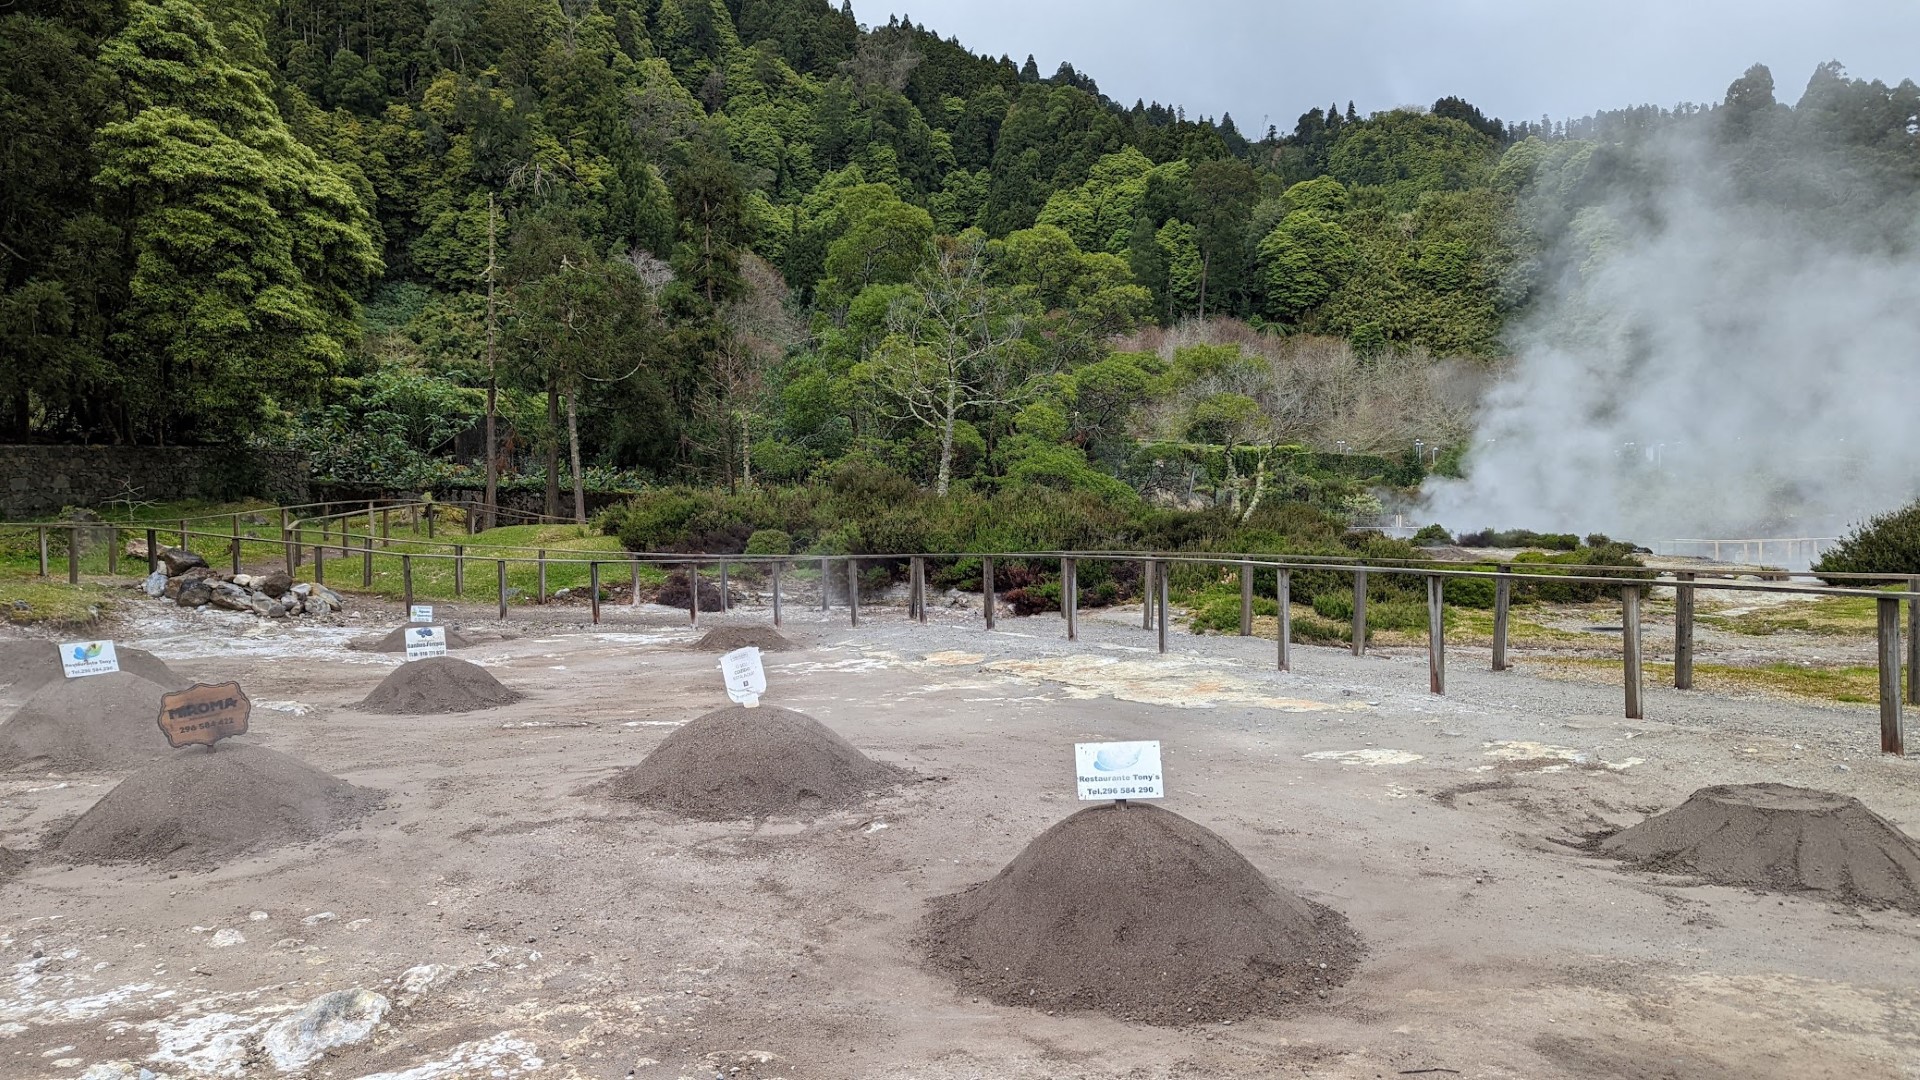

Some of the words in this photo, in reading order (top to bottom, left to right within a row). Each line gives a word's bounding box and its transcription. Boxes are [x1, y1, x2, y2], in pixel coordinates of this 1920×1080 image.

[168, 698, 238, 719] MIROMA
[180, 724, 197, 734] 296
[1079, 774, 1131, 783] Restaurante
[1087, 787, 1118, 795] Tel.296
[1120, 786, 1136, 794] 584
[1138, 786, 1154, 794] 290
